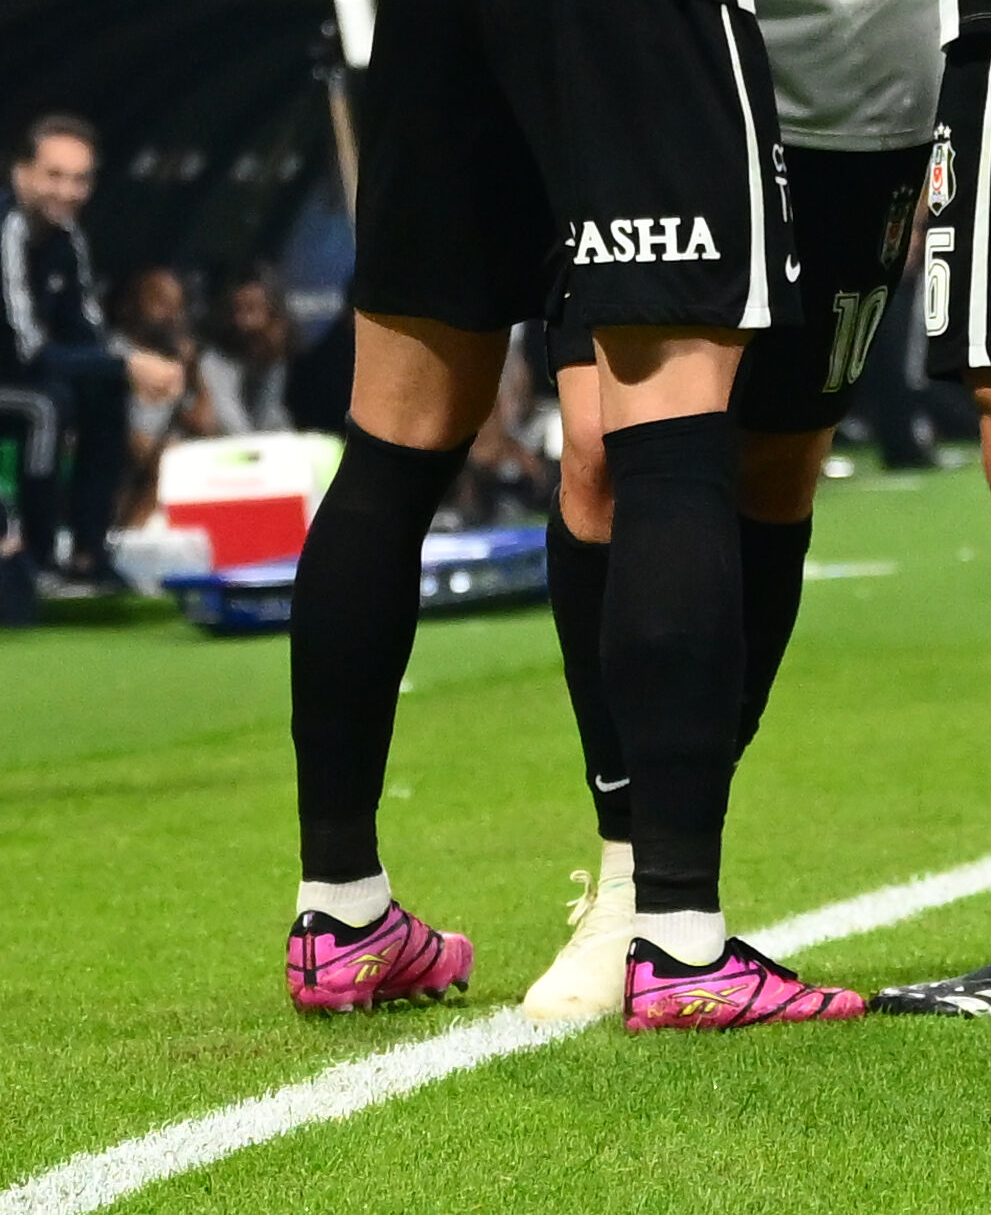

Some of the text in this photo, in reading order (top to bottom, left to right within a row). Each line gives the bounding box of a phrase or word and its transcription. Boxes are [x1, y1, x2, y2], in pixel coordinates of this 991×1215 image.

[565, 217, 721, 264] ASHA
[924, 227, 955, 336] 6
[822, 286, 888, 392] 10
